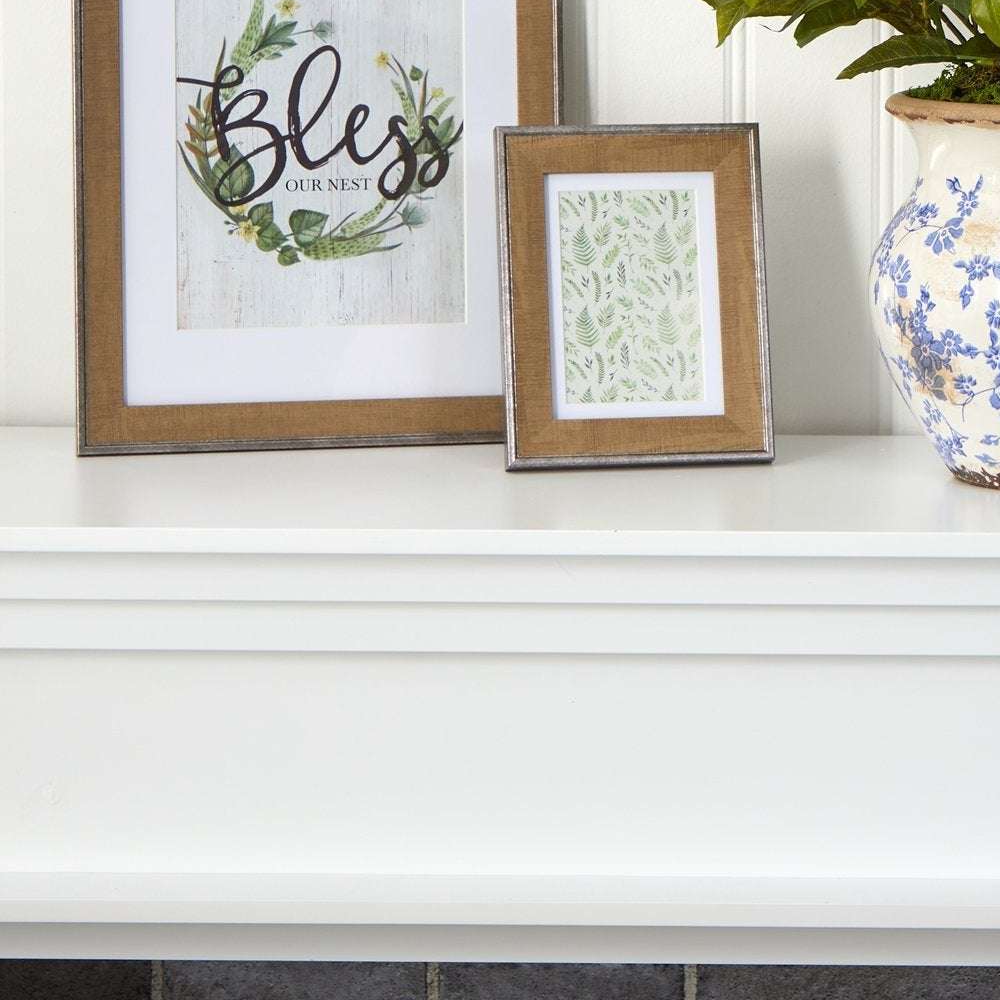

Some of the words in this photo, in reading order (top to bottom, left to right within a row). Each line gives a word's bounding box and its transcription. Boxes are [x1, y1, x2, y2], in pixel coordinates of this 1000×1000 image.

[176, 45, 463, 207] Bless
[285, 178, 322, 192] OUR
[328, 178, 372, 192] NEST
